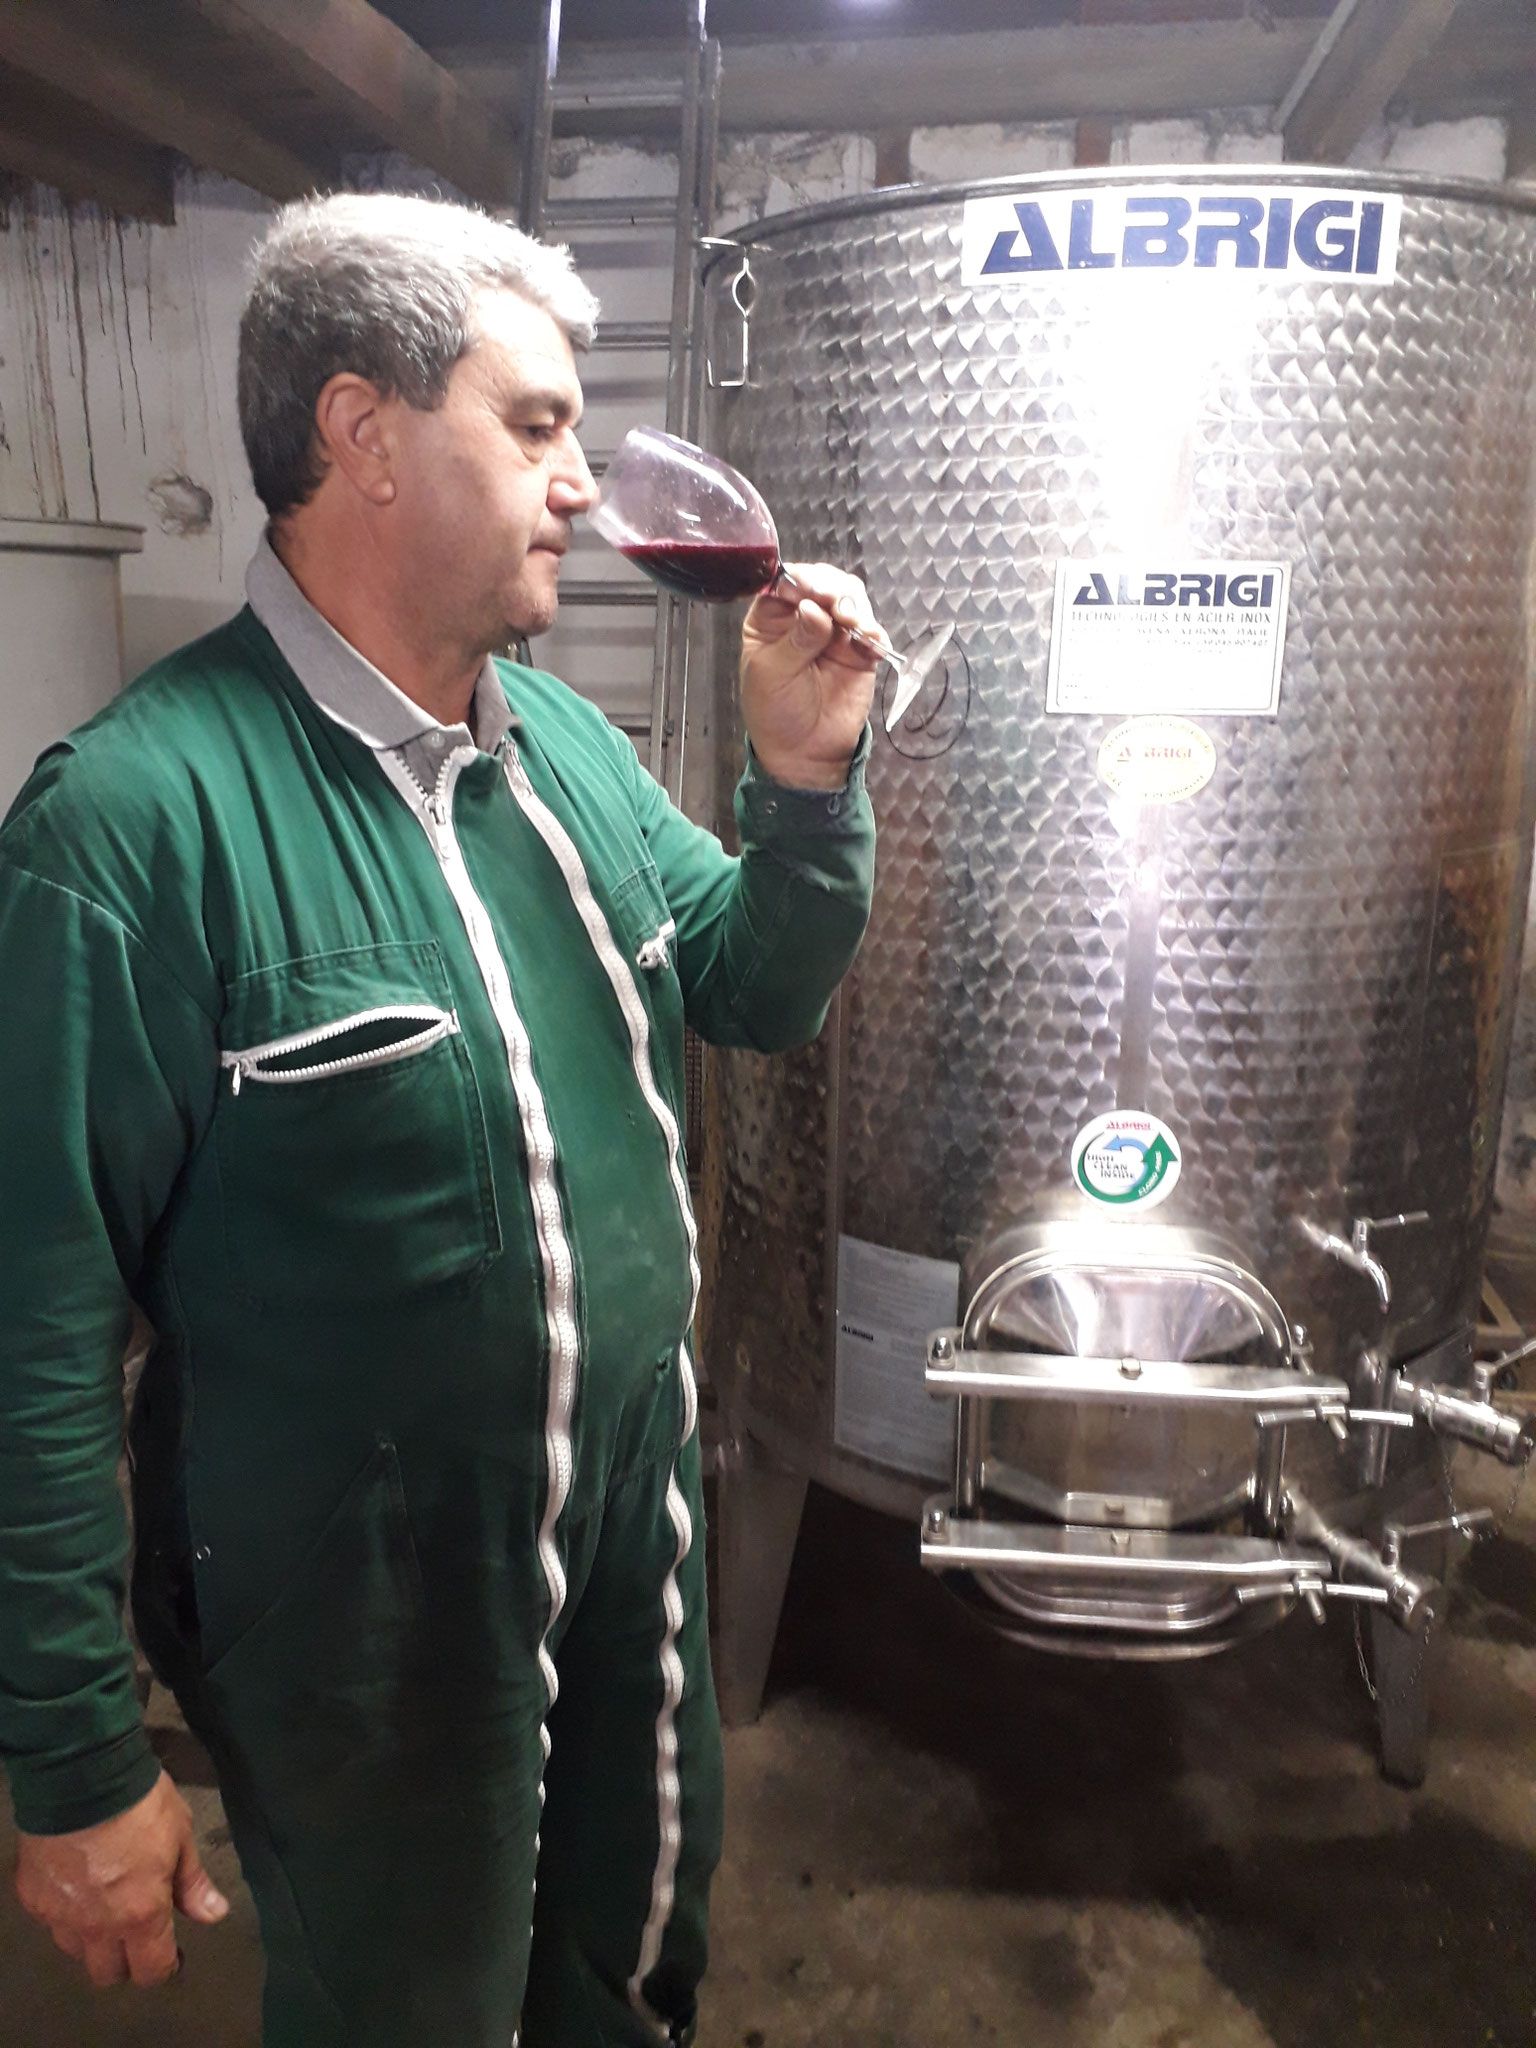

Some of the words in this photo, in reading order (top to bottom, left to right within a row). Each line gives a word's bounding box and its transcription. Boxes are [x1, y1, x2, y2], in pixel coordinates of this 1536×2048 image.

[980, 196, 1384, 275] ALBRIGI
[1072, 573, 1275, 608] ALBRIGI
[1071, 610, 1169, 623] TECHNOOGIES
[1240, 613, 1272, 625] INOX
